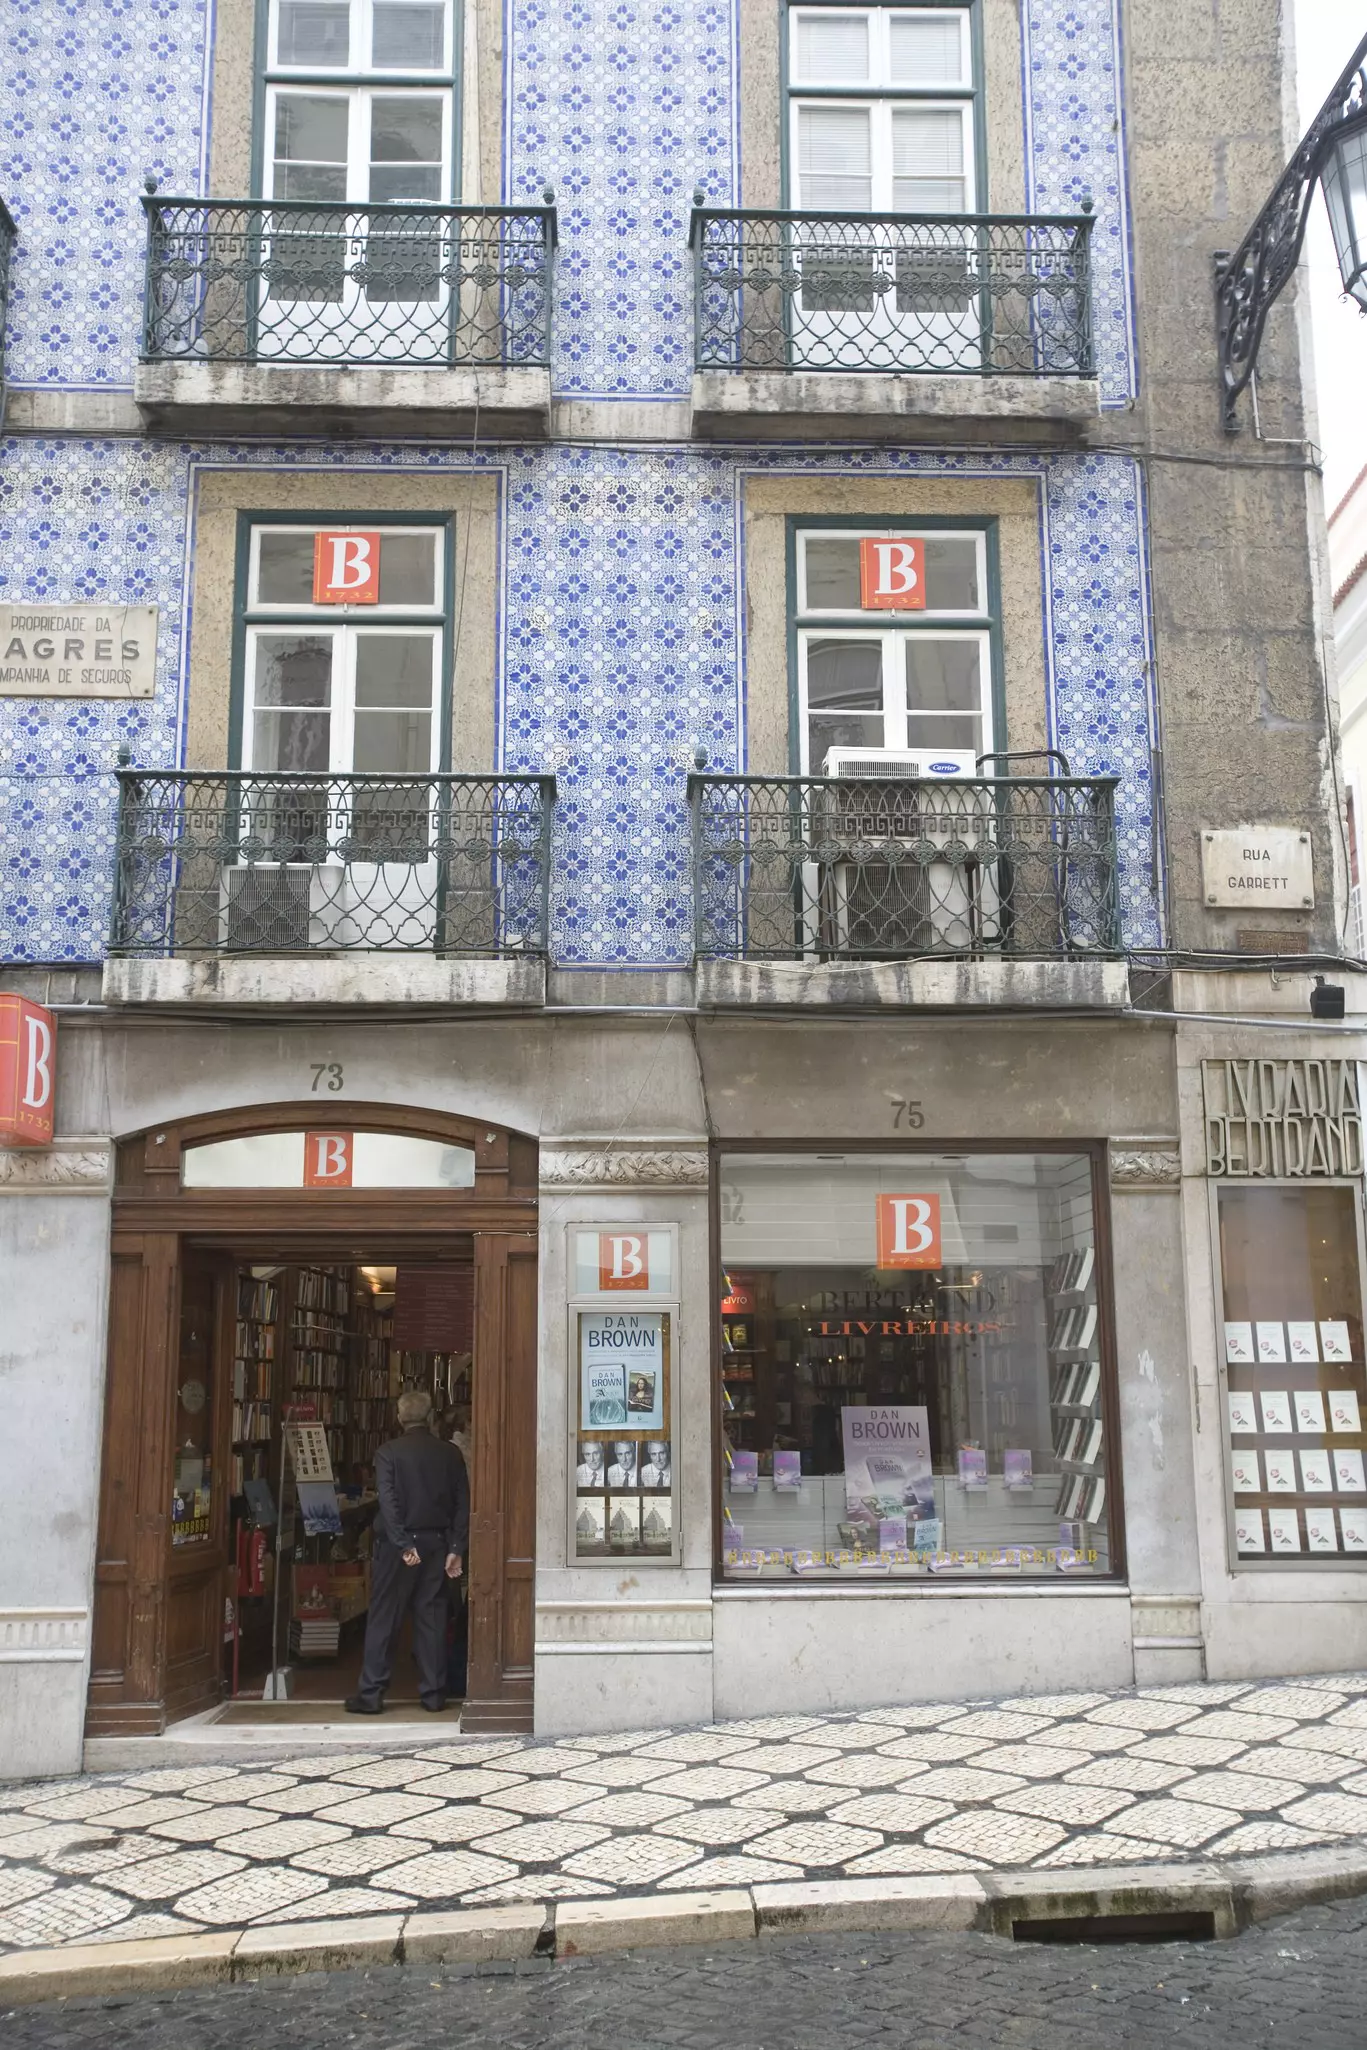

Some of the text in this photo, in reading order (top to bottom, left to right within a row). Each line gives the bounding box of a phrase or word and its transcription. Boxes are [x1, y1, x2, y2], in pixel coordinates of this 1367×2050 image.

[326, 537, 372, 589] B
[873, 543, 918, 595] B
[324, 591, 376, 599] 1732
[872, 597, 921, 605] 1732
[11, 615, 111, 633] PROPRIEDADE DA
[58, 668, 73, 684] DE
[81, 668, 132, 684] SEGUROS
[932, 763, 958, 771] Carrier
[1243, 849, 1271, 860] RUA
[1228, 877, 1288, 889] GARRETT
[22, 1014, 51, 1108] B
[310, 1063, 344, 1092] 73
[1202, 1059, 1361, 1117] LIVRARIA
[20, 1111, 51, 1131] 1732
[891, 1101, 925, 1129] 75
[1206, 1117, 1364, 1176] BERTRAND
[314, 1136, 347, 1177] B
[889, 1199, 933, 1254] B
[609, 1237, 643, 1279] B
[889, 1257, 938, 1265] 1732
[820, 1290, 996, 1314] BERTRND
[604, 1316, 639, 1328] DAN
[820, 1320, 1003, 1335] LIVREIROS
[588, 1330, 655, 1348] BROWN
[591, 1378, 622, 1388] BROWN
[870, 1410, 900, 1420] DAN
[852, 1422, 920, 1439] BROWN
